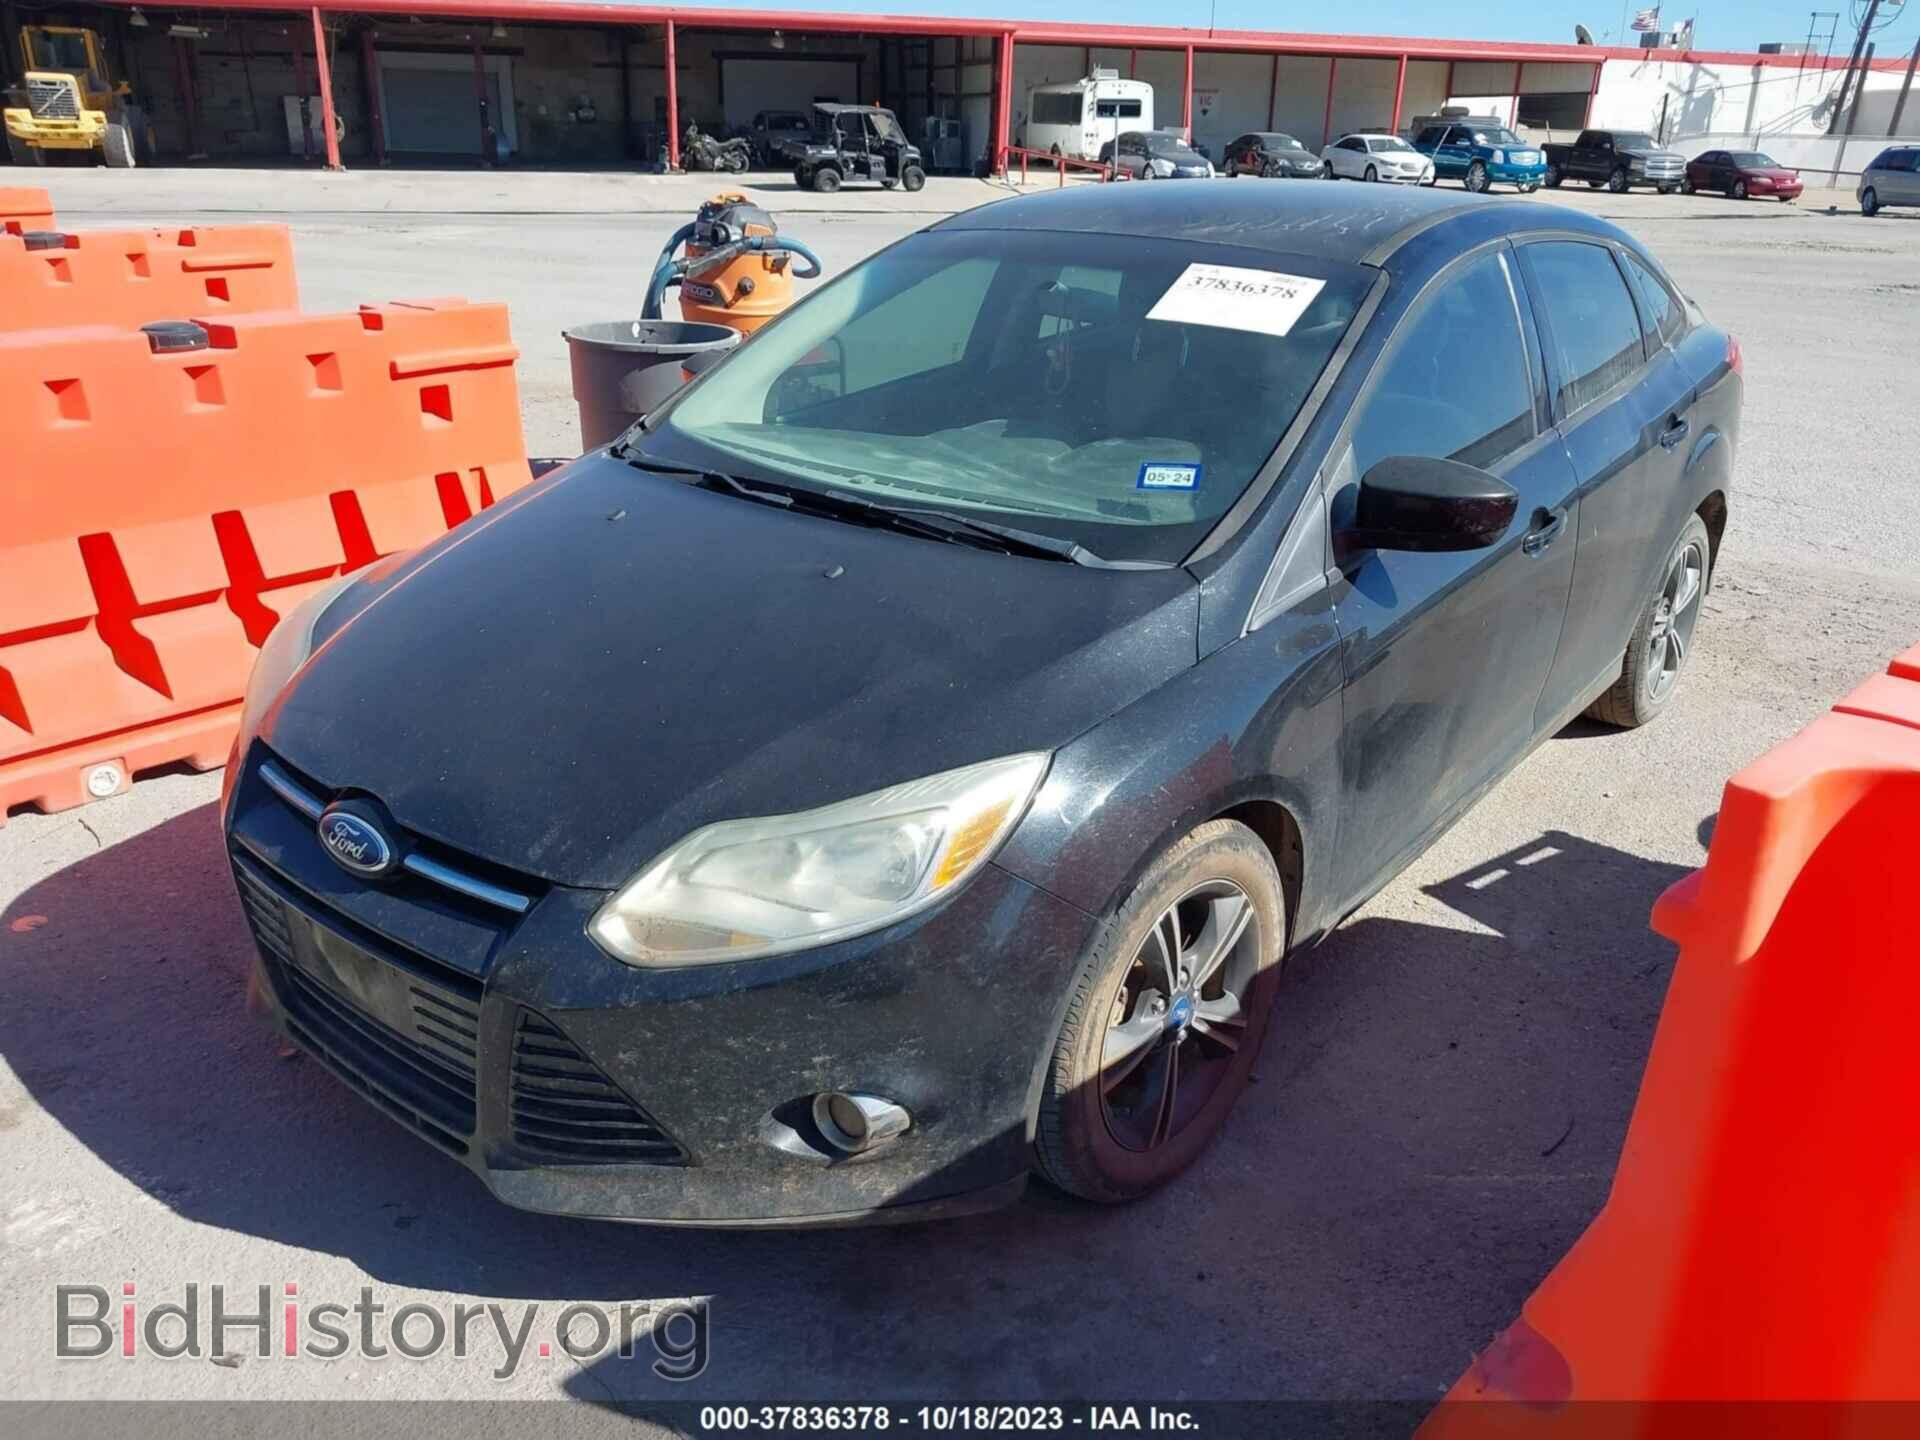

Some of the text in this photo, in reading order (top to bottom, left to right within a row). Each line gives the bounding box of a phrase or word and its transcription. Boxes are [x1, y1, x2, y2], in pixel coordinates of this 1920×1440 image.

[682, 283, 714, 298] DGID
[1187, 276, 1298, 299] 37836378
[1147, 472, 1192, 483] 05 24
[328, 821, 368, 860] Ford
